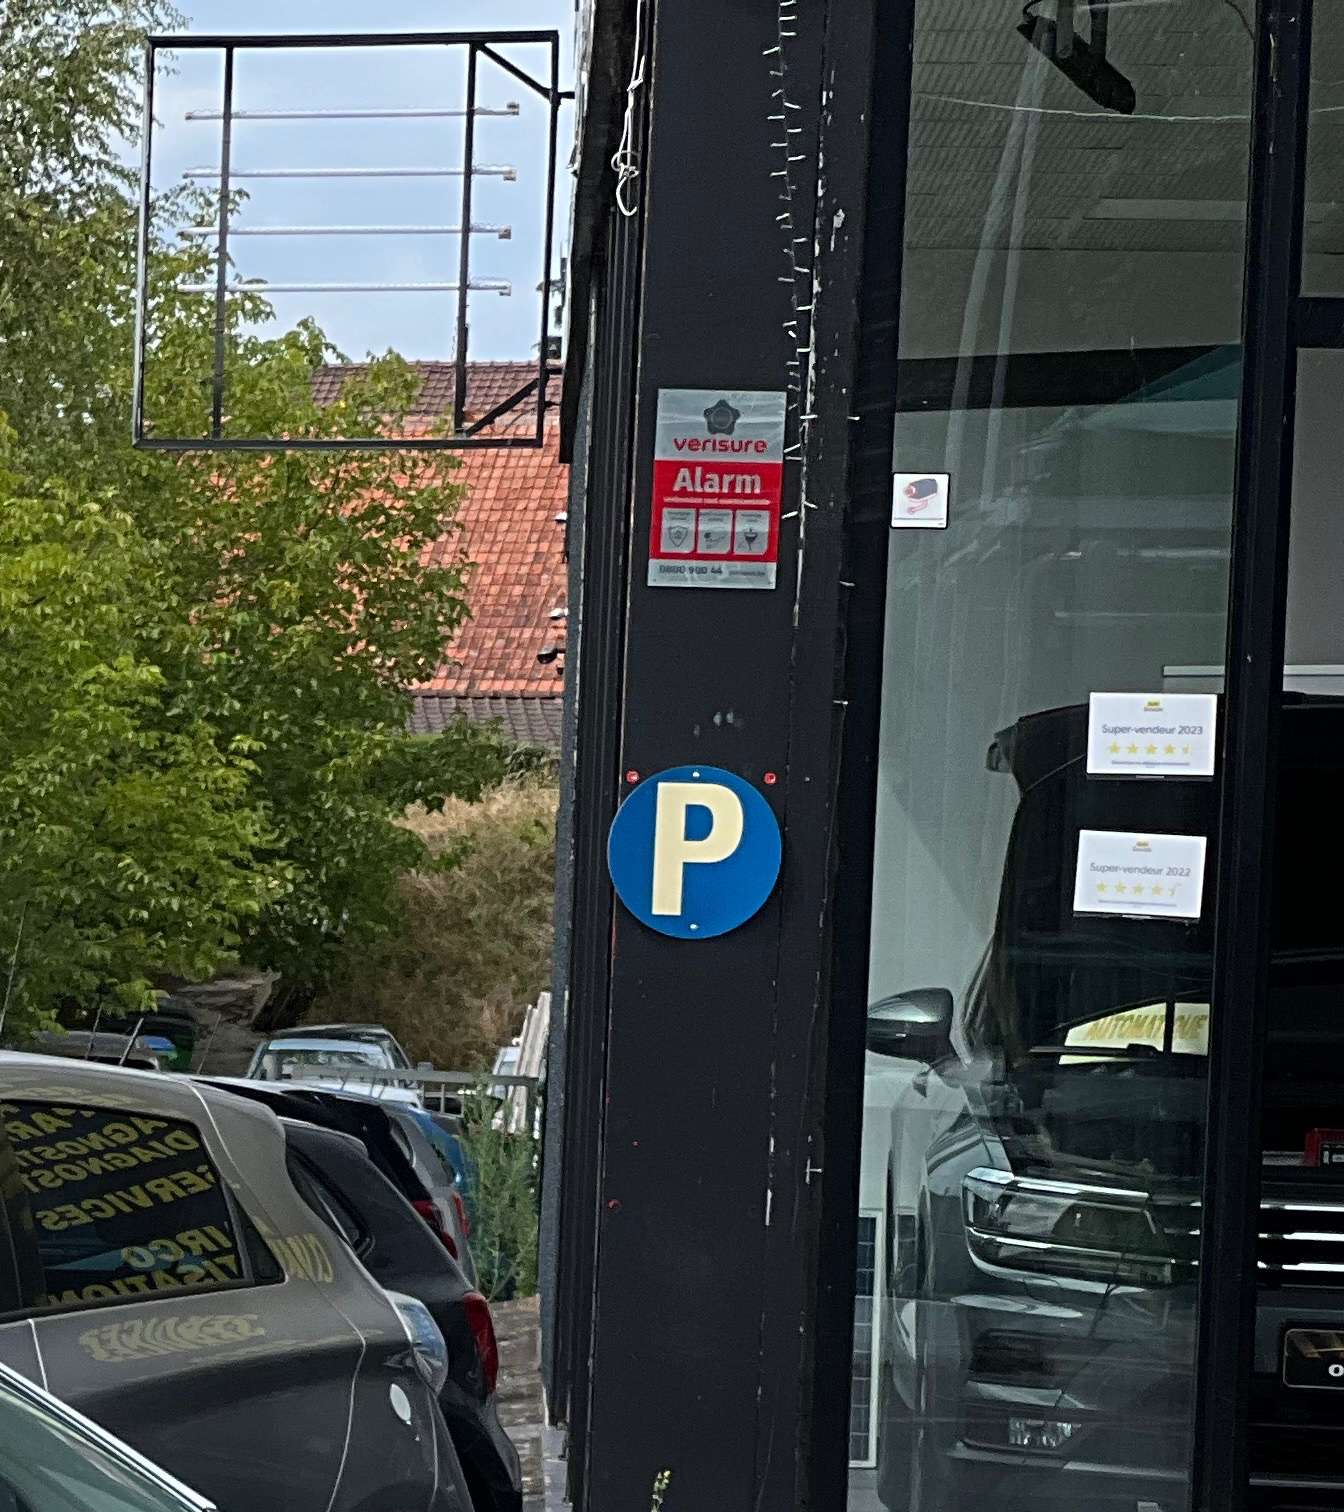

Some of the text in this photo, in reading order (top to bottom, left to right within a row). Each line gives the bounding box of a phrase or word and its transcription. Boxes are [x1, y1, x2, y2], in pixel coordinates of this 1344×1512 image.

[673, 437, 769, 453] verisure
[672, 466, 762, 495] Alarm
[1102, 724, 1204, 736] Super-vendeur 2023
[651, 782, 744, 917] P
[1090, 862, 1192, 877] Super-vendeur 2022
